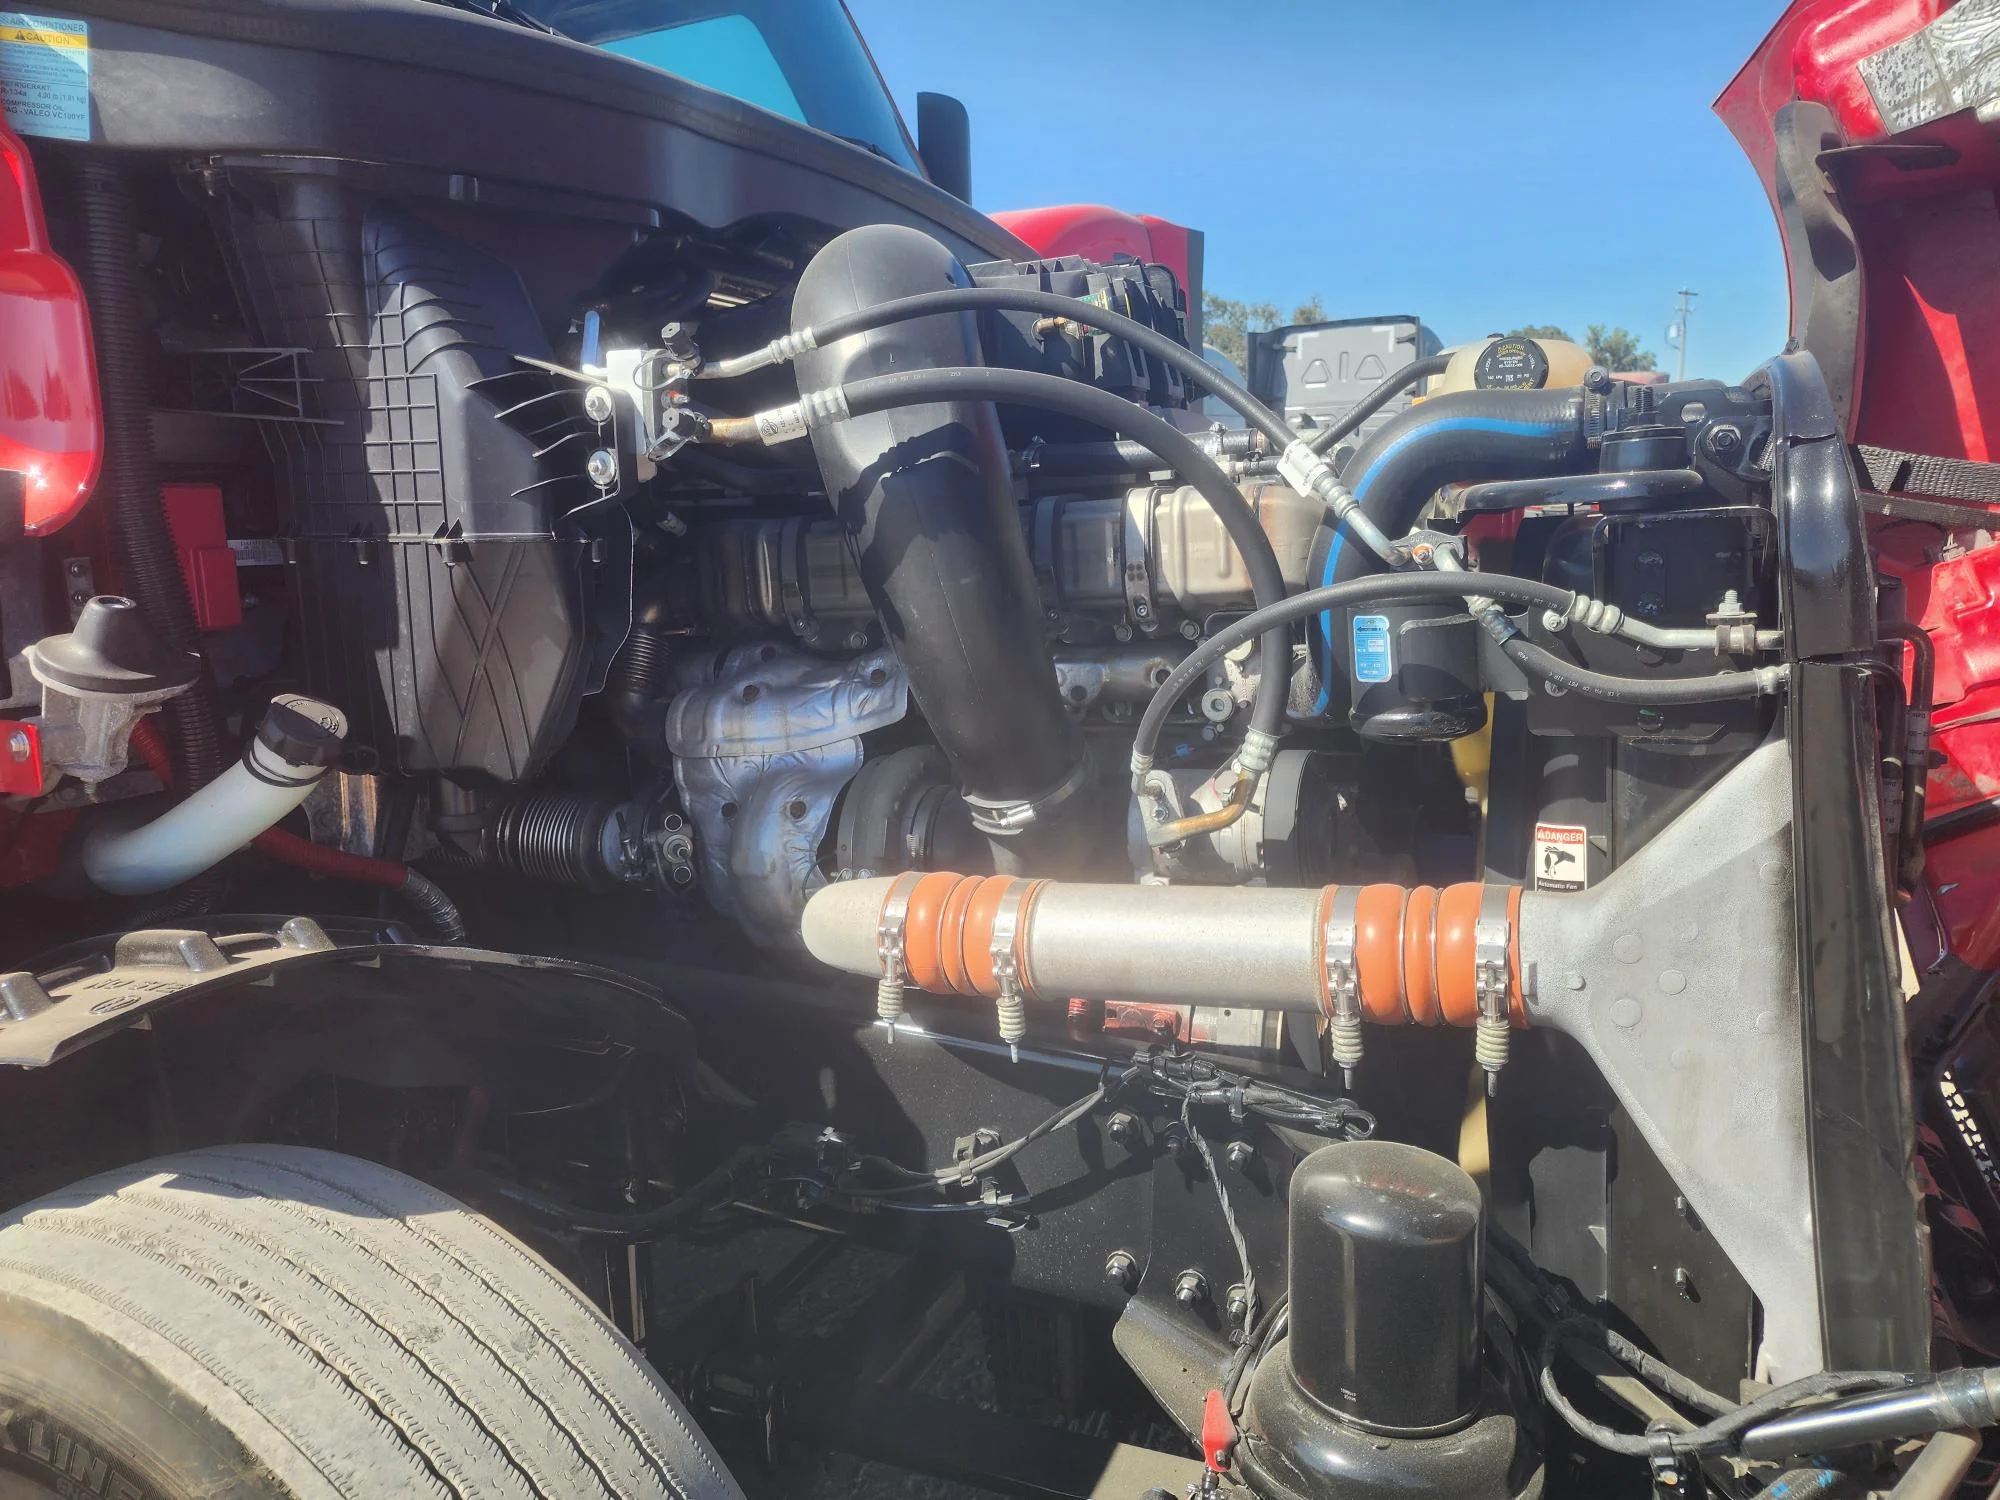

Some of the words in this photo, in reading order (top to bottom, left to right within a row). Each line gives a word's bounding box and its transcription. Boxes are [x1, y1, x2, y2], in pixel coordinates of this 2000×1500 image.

[26, 32, 70, 45] CAUTION
[24, 108, 51, 117] VALEO
[1545, 831, 1582, 842] DANGER
[1538, 880, 1565, 889] Automatic
